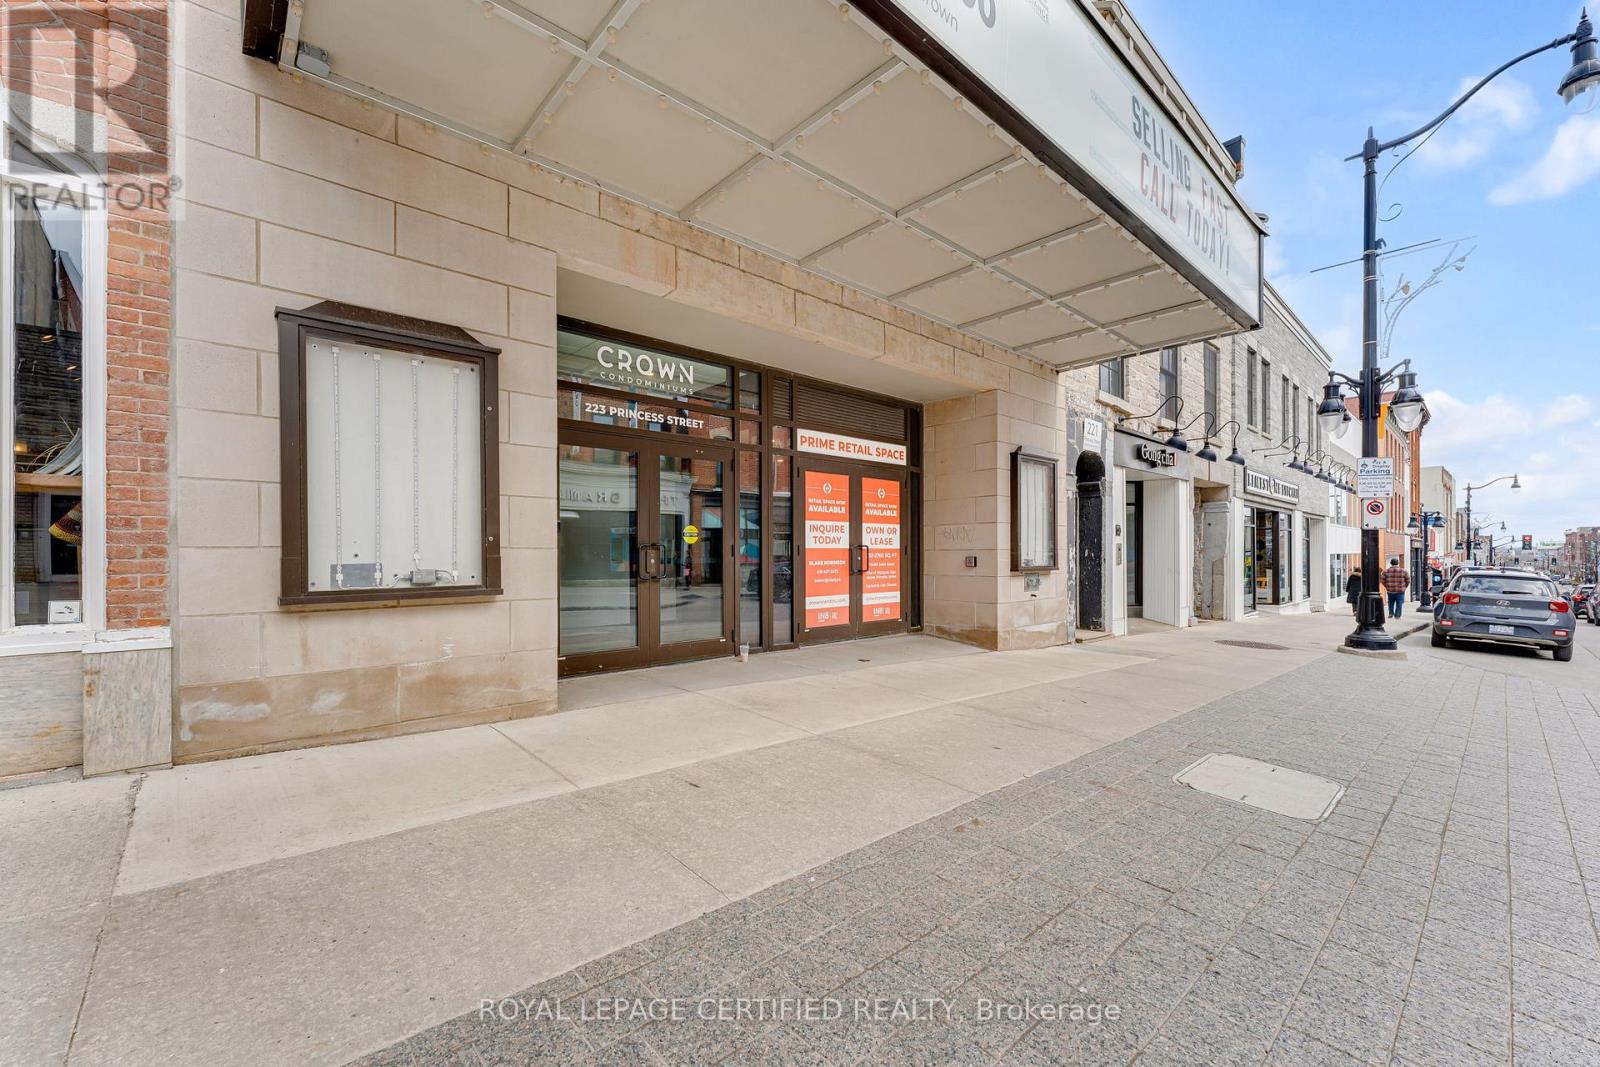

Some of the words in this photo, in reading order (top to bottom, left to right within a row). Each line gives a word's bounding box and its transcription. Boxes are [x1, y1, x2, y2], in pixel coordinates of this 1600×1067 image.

[1132, 95, 1191, 192] SELLING
[1201, 175, 1230, 236] FAST
[1139, 151, 1177, 224] CALL
[1186, 199, 1231, 277] TODAY!
[597, 345, 694, 385] CROWN
[600, 371, 694, 395] CONDOMINIUMS
[585, 402, 606, 415] 223
[609, 406, 665, 423] PRINCESS
[667, 415, 704, 429] STREET
[800, 435, 835, 450] PRIME
[838, 441, 872, 456] RETAIL
[875, 447, 905, 460] SPACE
[1141, 443, 1161, 467] Gong
[808, 505, 846, 514] AVAILABLE
[865, 508, 897, 517] AVAILABLE
[809, 524, 845, 535] INQUIRE
[813, 535, 842, 545] TODAY
[865, 526, 885, 534] OWN
[870, 537, 893, 546] LEASE
